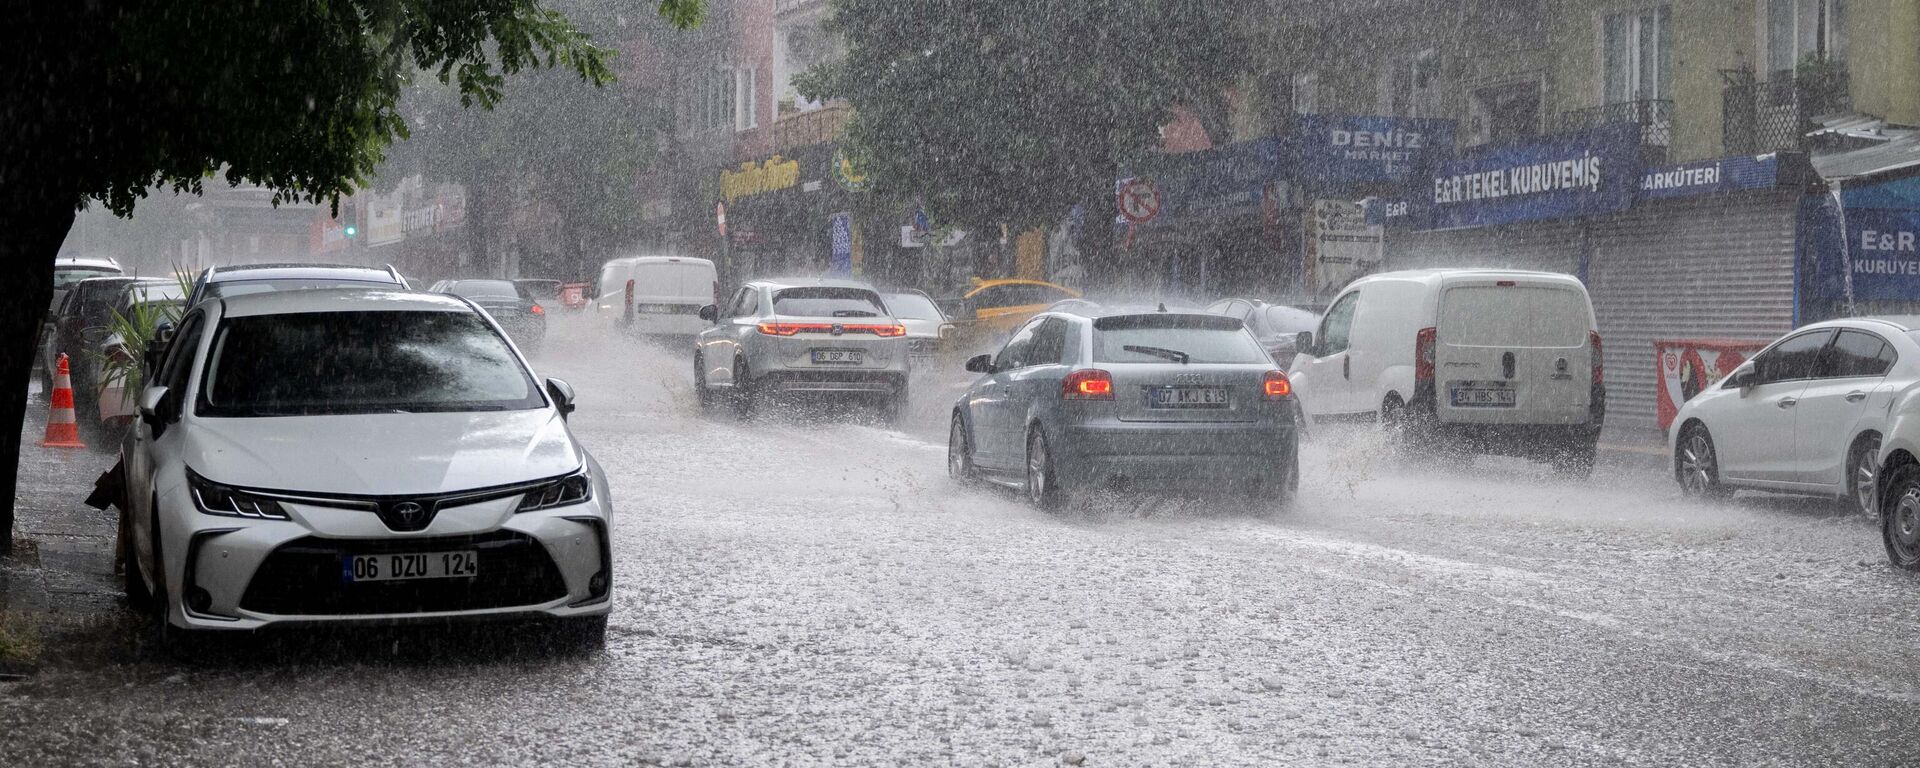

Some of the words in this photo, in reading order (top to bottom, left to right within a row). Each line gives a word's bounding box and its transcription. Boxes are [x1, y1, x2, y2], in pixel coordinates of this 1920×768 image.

[1332, 128, 1422, 148] DENİZ
[1345, 149, 1413, 161] MARKET
[1435, 176, 1461, 203] E&R
[1464, 169, 1508, 201] TEKEL
[1511, 150, 1600, 195] KURUYEMİŞ
[1386, 202, 1407, 217] E&R
[1861, 230, 1915, 252] E&R
[1854, 260, 1920, 275] KURUYE
[1159, 390, 1172, 403] 07
[354, 556, 379, 579] 06
[391, 554, 428, 578] DZU
[442, 553, 476, 576] 124
